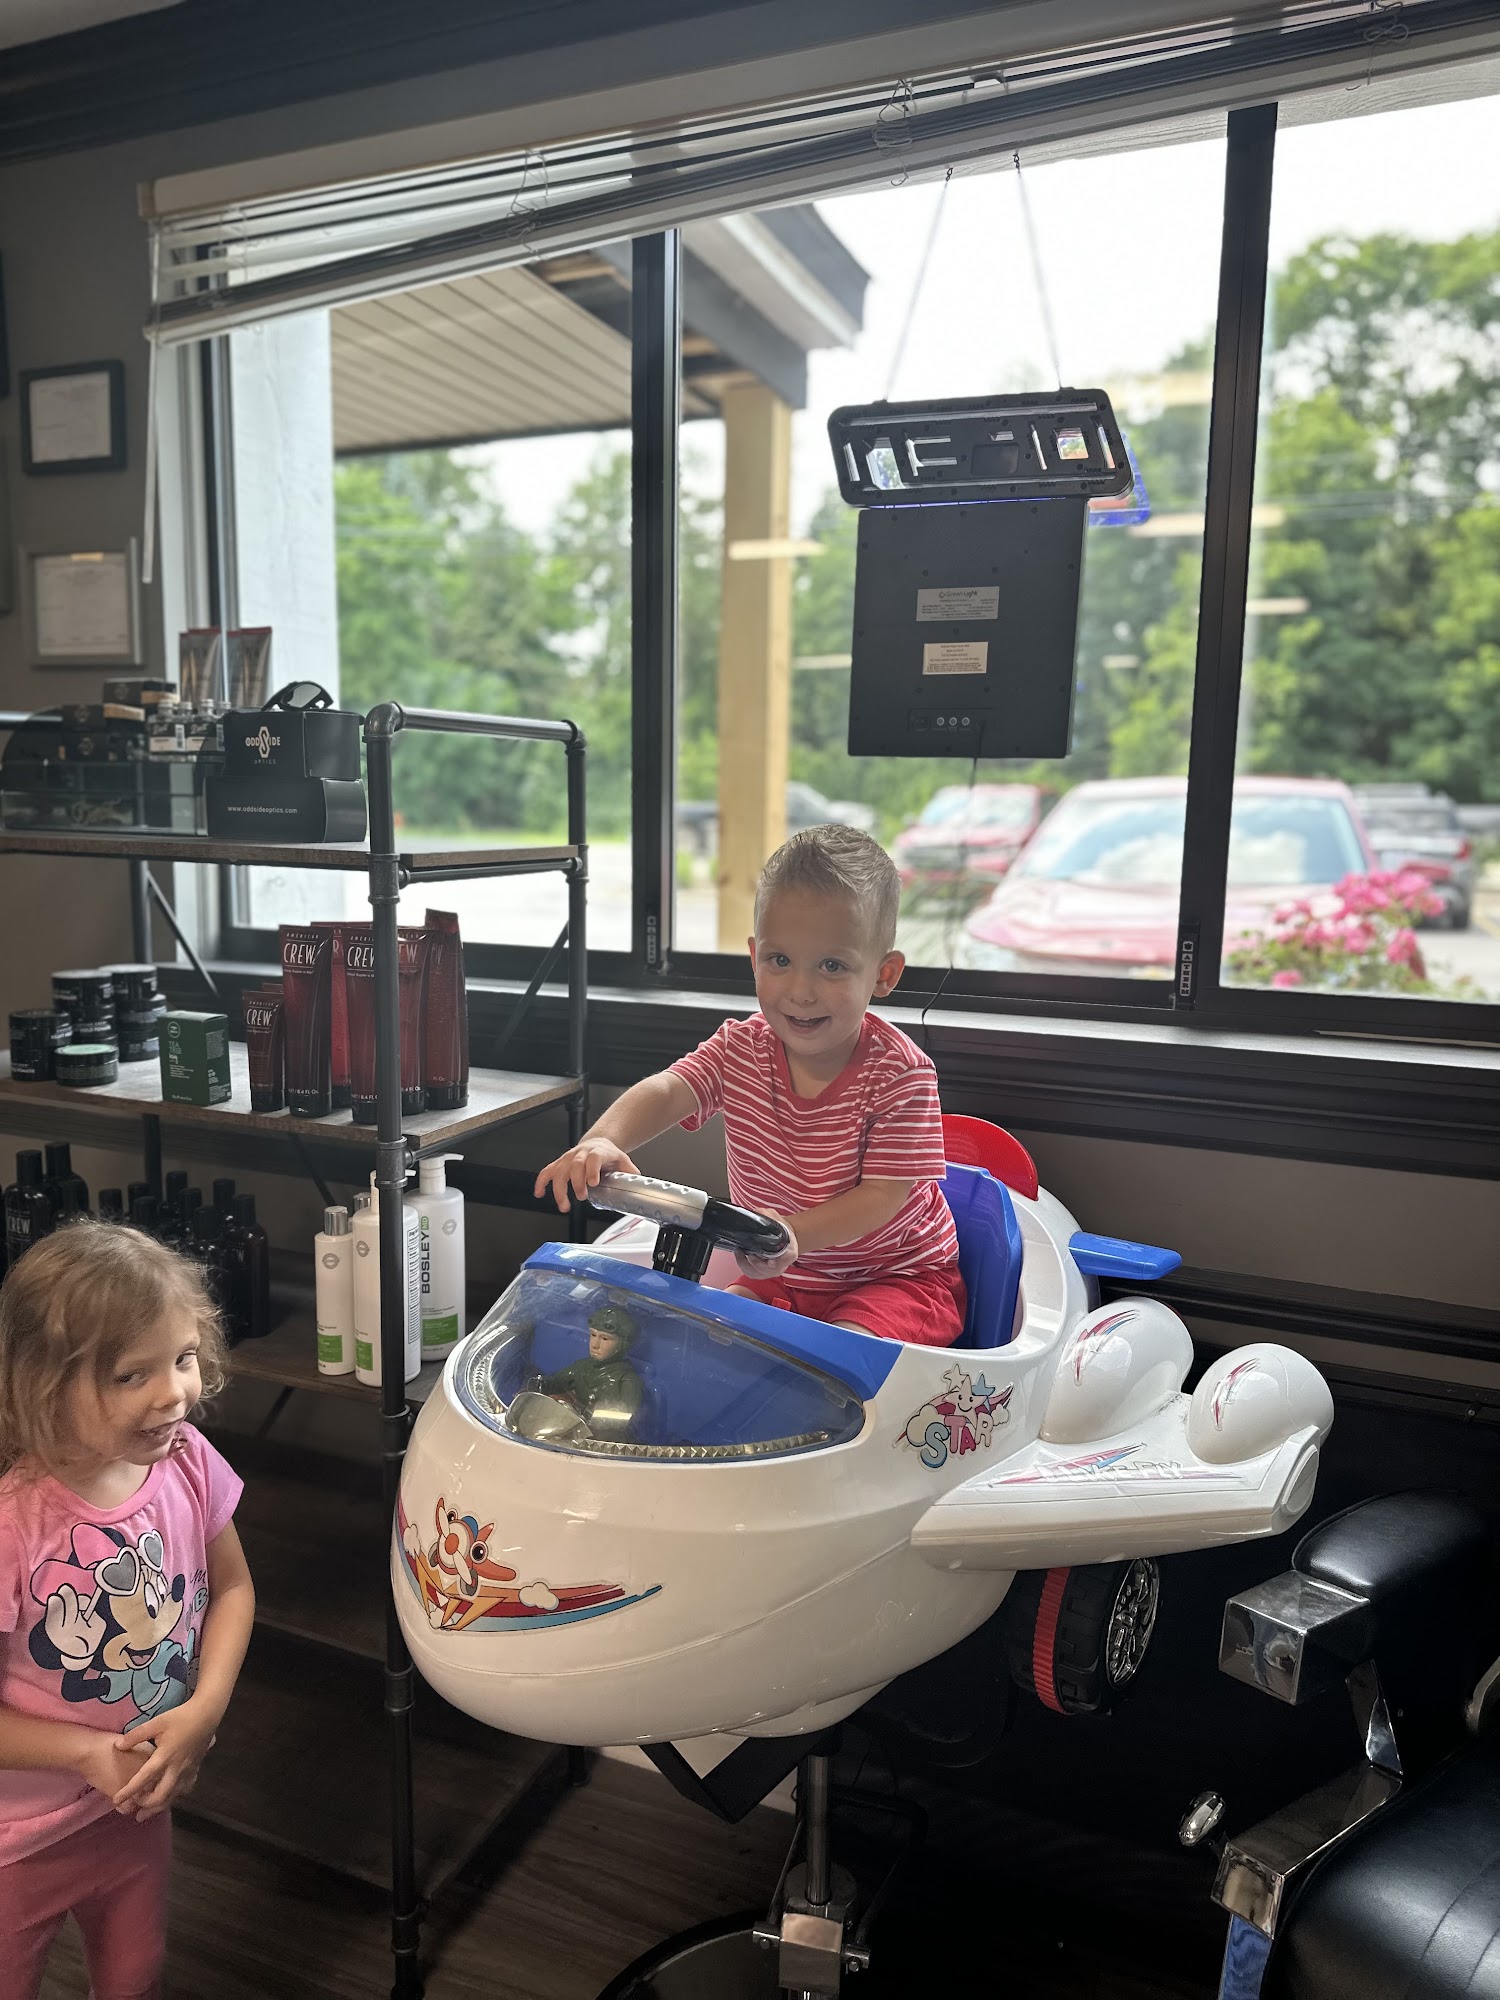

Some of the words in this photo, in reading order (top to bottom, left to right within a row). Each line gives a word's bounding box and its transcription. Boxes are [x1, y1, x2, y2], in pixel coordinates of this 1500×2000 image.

[227, 806, 298, 815] www.oddsideoptics.com
[283, 942, 317, 965] CREW
[246, 1008, 273, 1027] CREW
[421, 1216, 429, 1230] MD
[420, 1230, 431, 1294] BOSLEY
[920, 1411, 995, 1469] STAR
